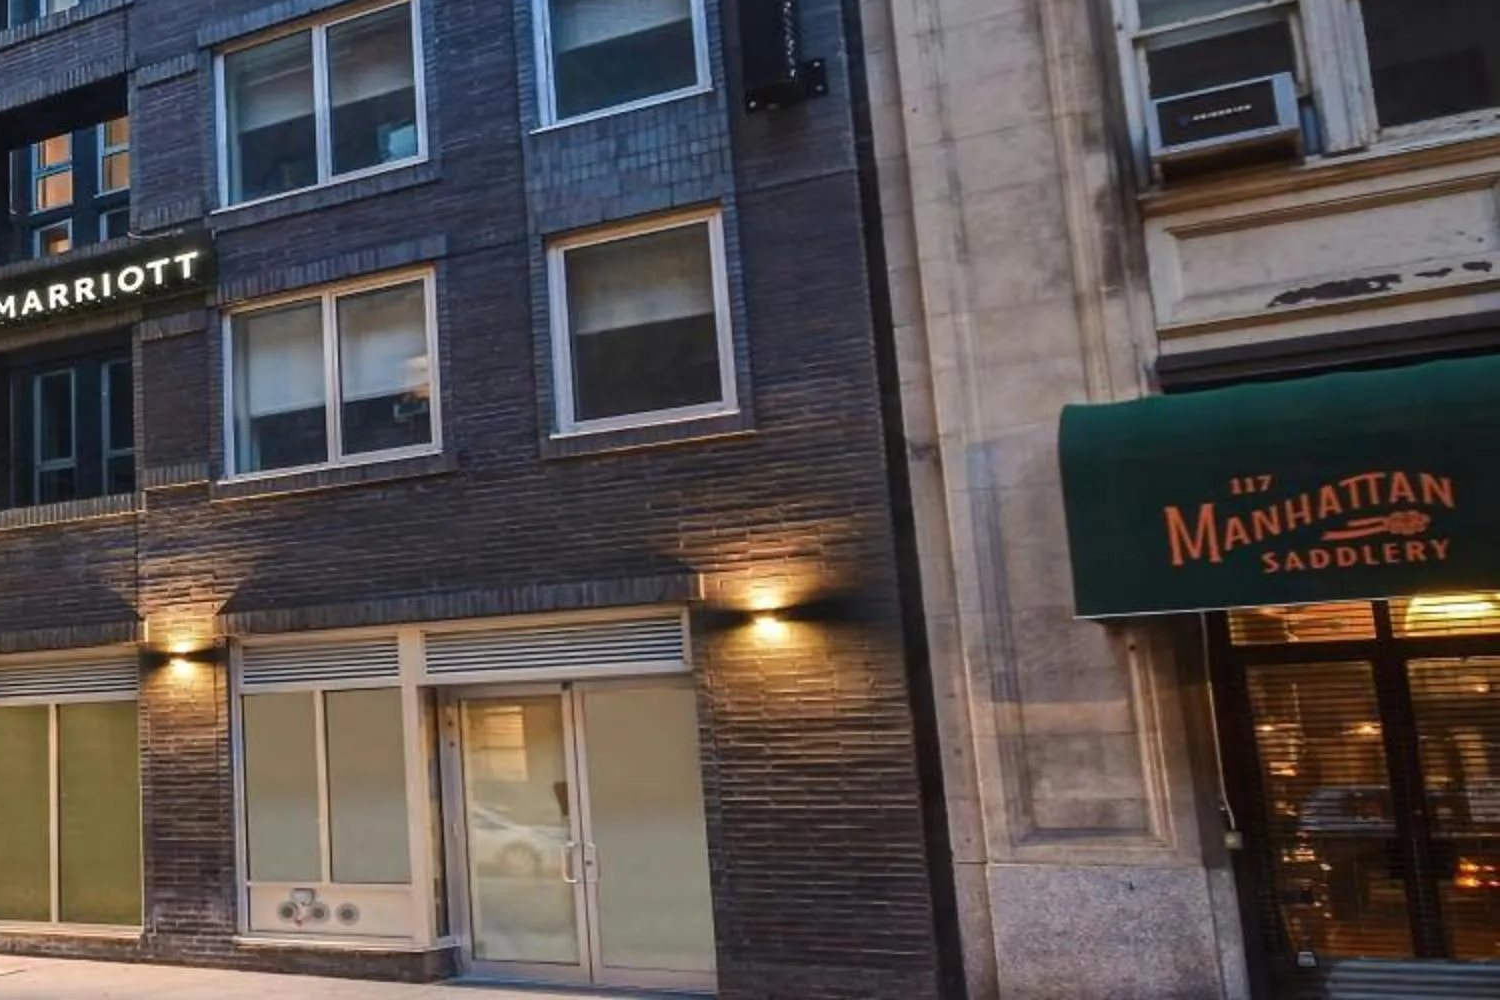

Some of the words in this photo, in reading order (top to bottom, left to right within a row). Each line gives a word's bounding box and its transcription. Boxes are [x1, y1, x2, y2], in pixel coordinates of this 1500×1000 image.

[1228, 474, 1274, 495] 117
[1164, 471, 1456, 567] MANHATTAN
[1260, 538, 1450, 574] SADDLERY
